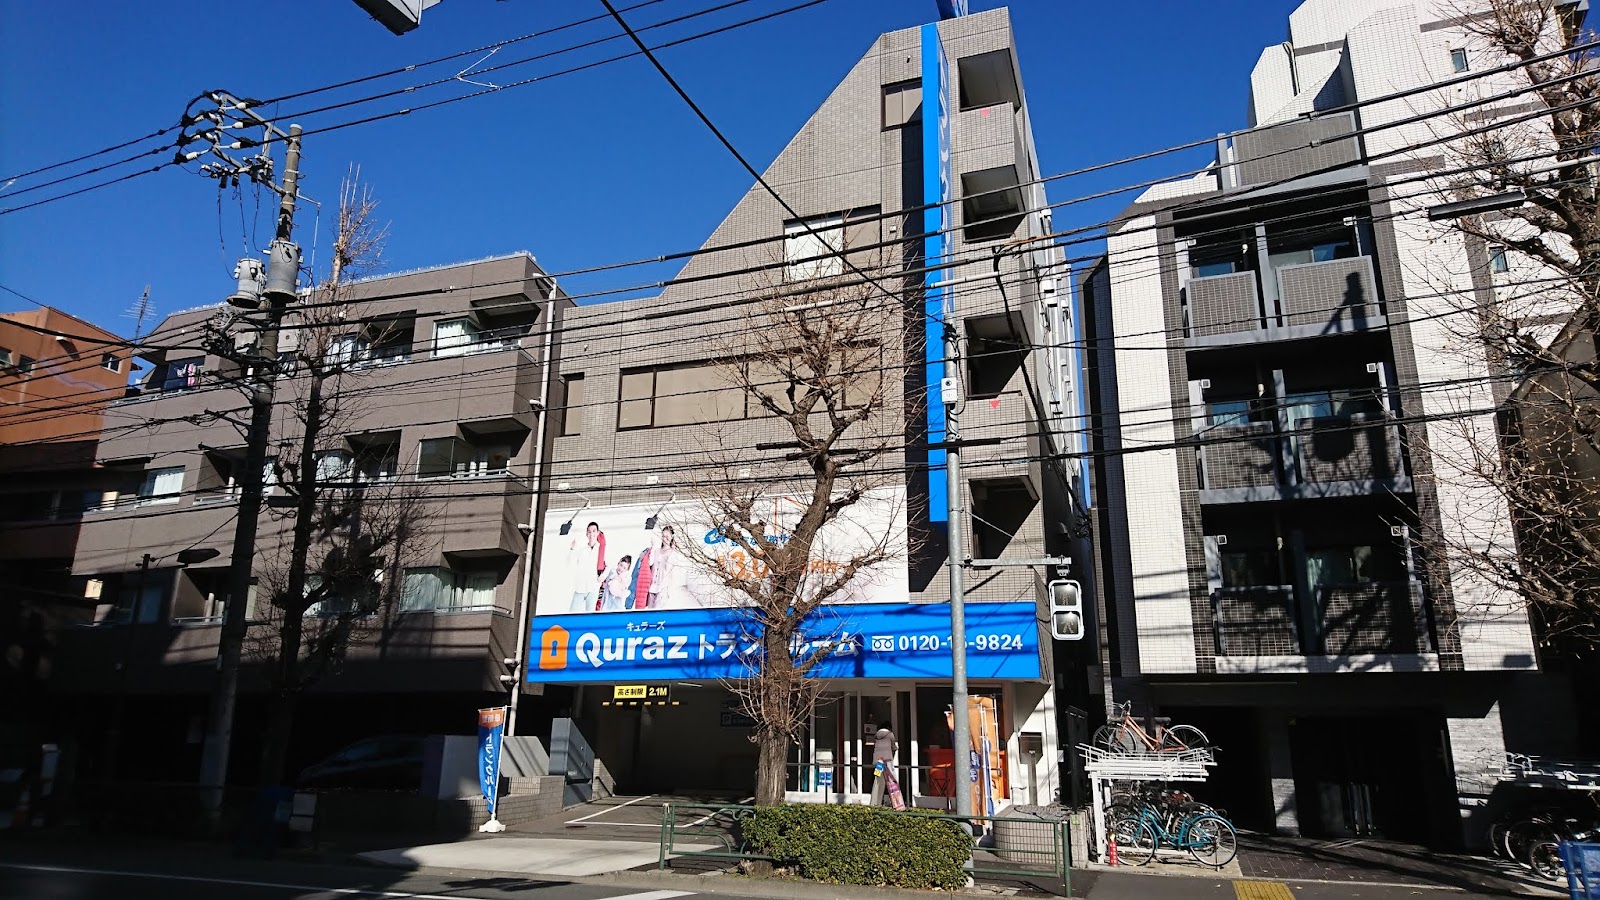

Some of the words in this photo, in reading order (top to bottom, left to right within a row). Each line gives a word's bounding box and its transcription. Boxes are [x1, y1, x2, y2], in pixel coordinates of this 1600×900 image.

[626, 620, 666, 632] キュラーズ
[576, 632, 688, 668] Quraz
[699, 631, 859, 660] トランルーム
[899, 634, 1023, 651] 0120-1-9824
[617, 688, 644, 697] 高さ制限
[648, 687, 668, 697] 2.1M
